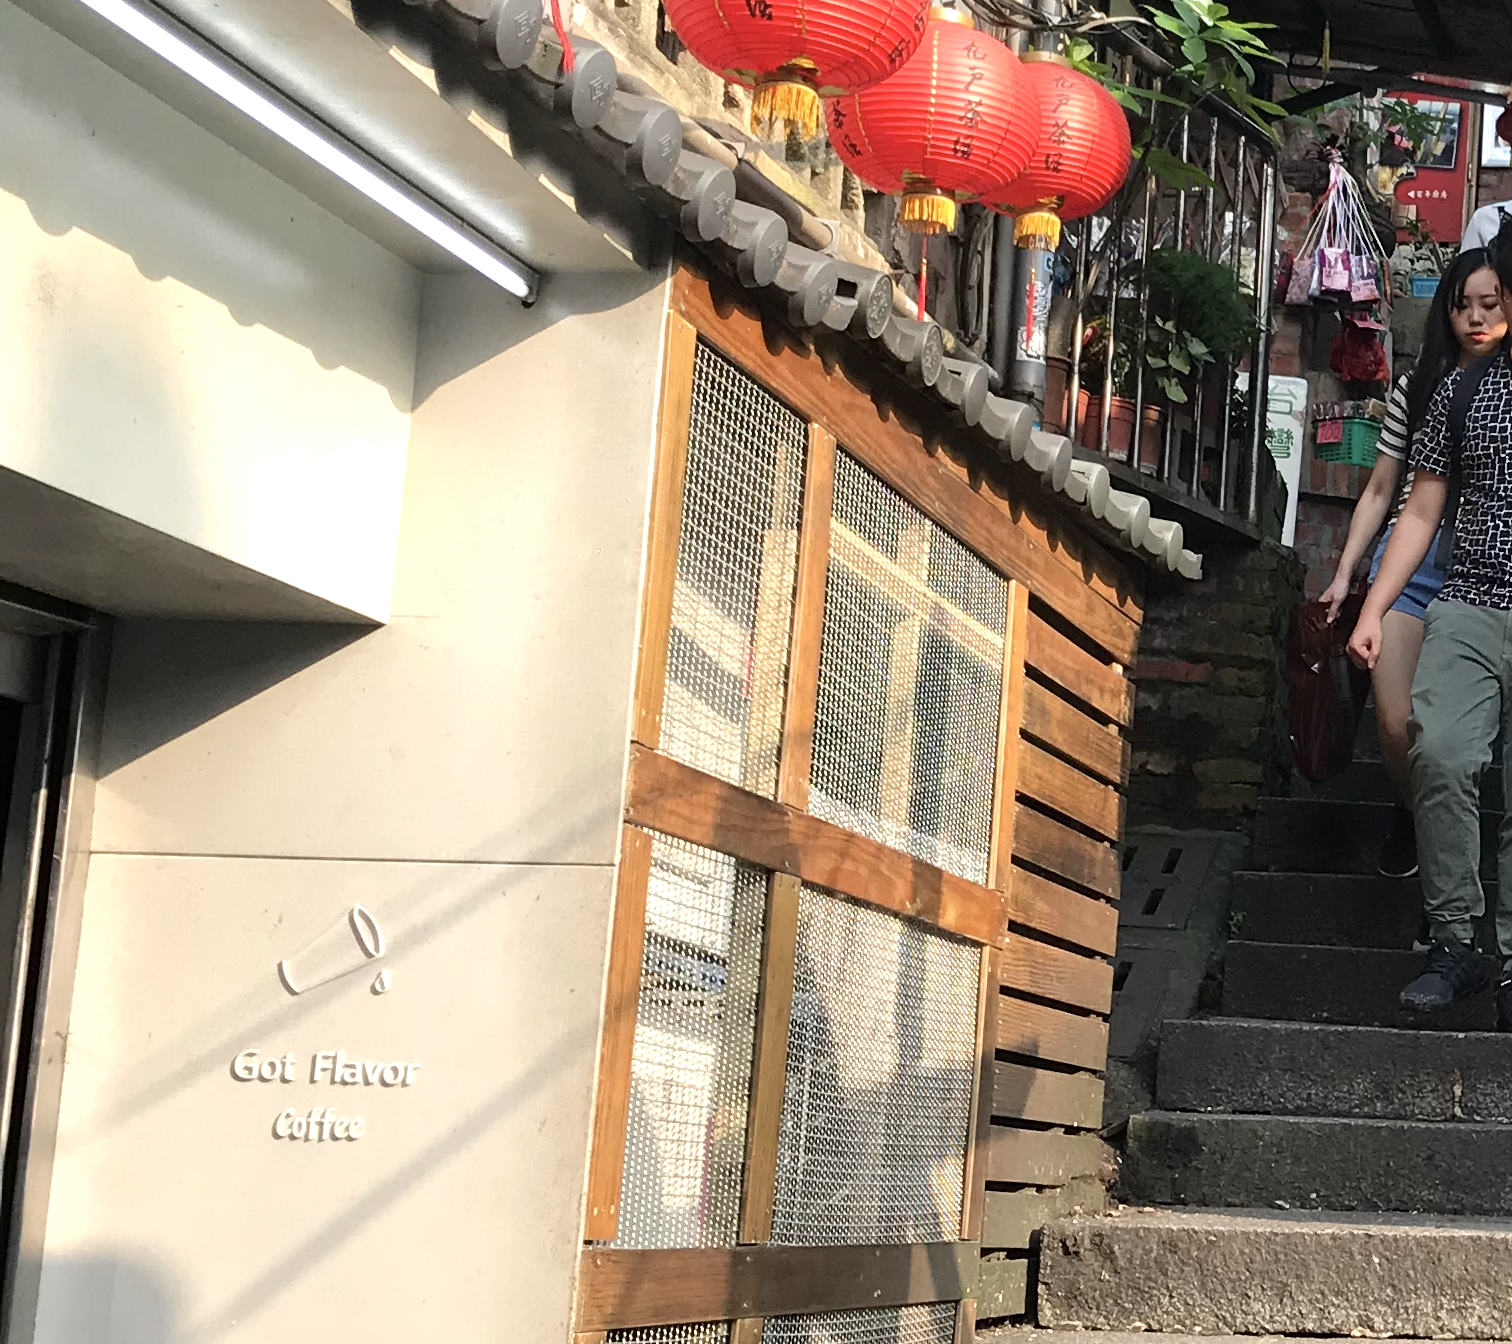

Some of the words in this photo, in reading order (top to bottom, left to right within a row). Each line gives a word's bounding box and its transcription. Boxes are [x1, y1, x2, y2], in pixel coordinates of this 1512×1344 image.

[230, 1047, 298, 1084] Got
[308, 1047, 421, 1088] Flavor
[270, 1106, 367, 1143] Coffee
